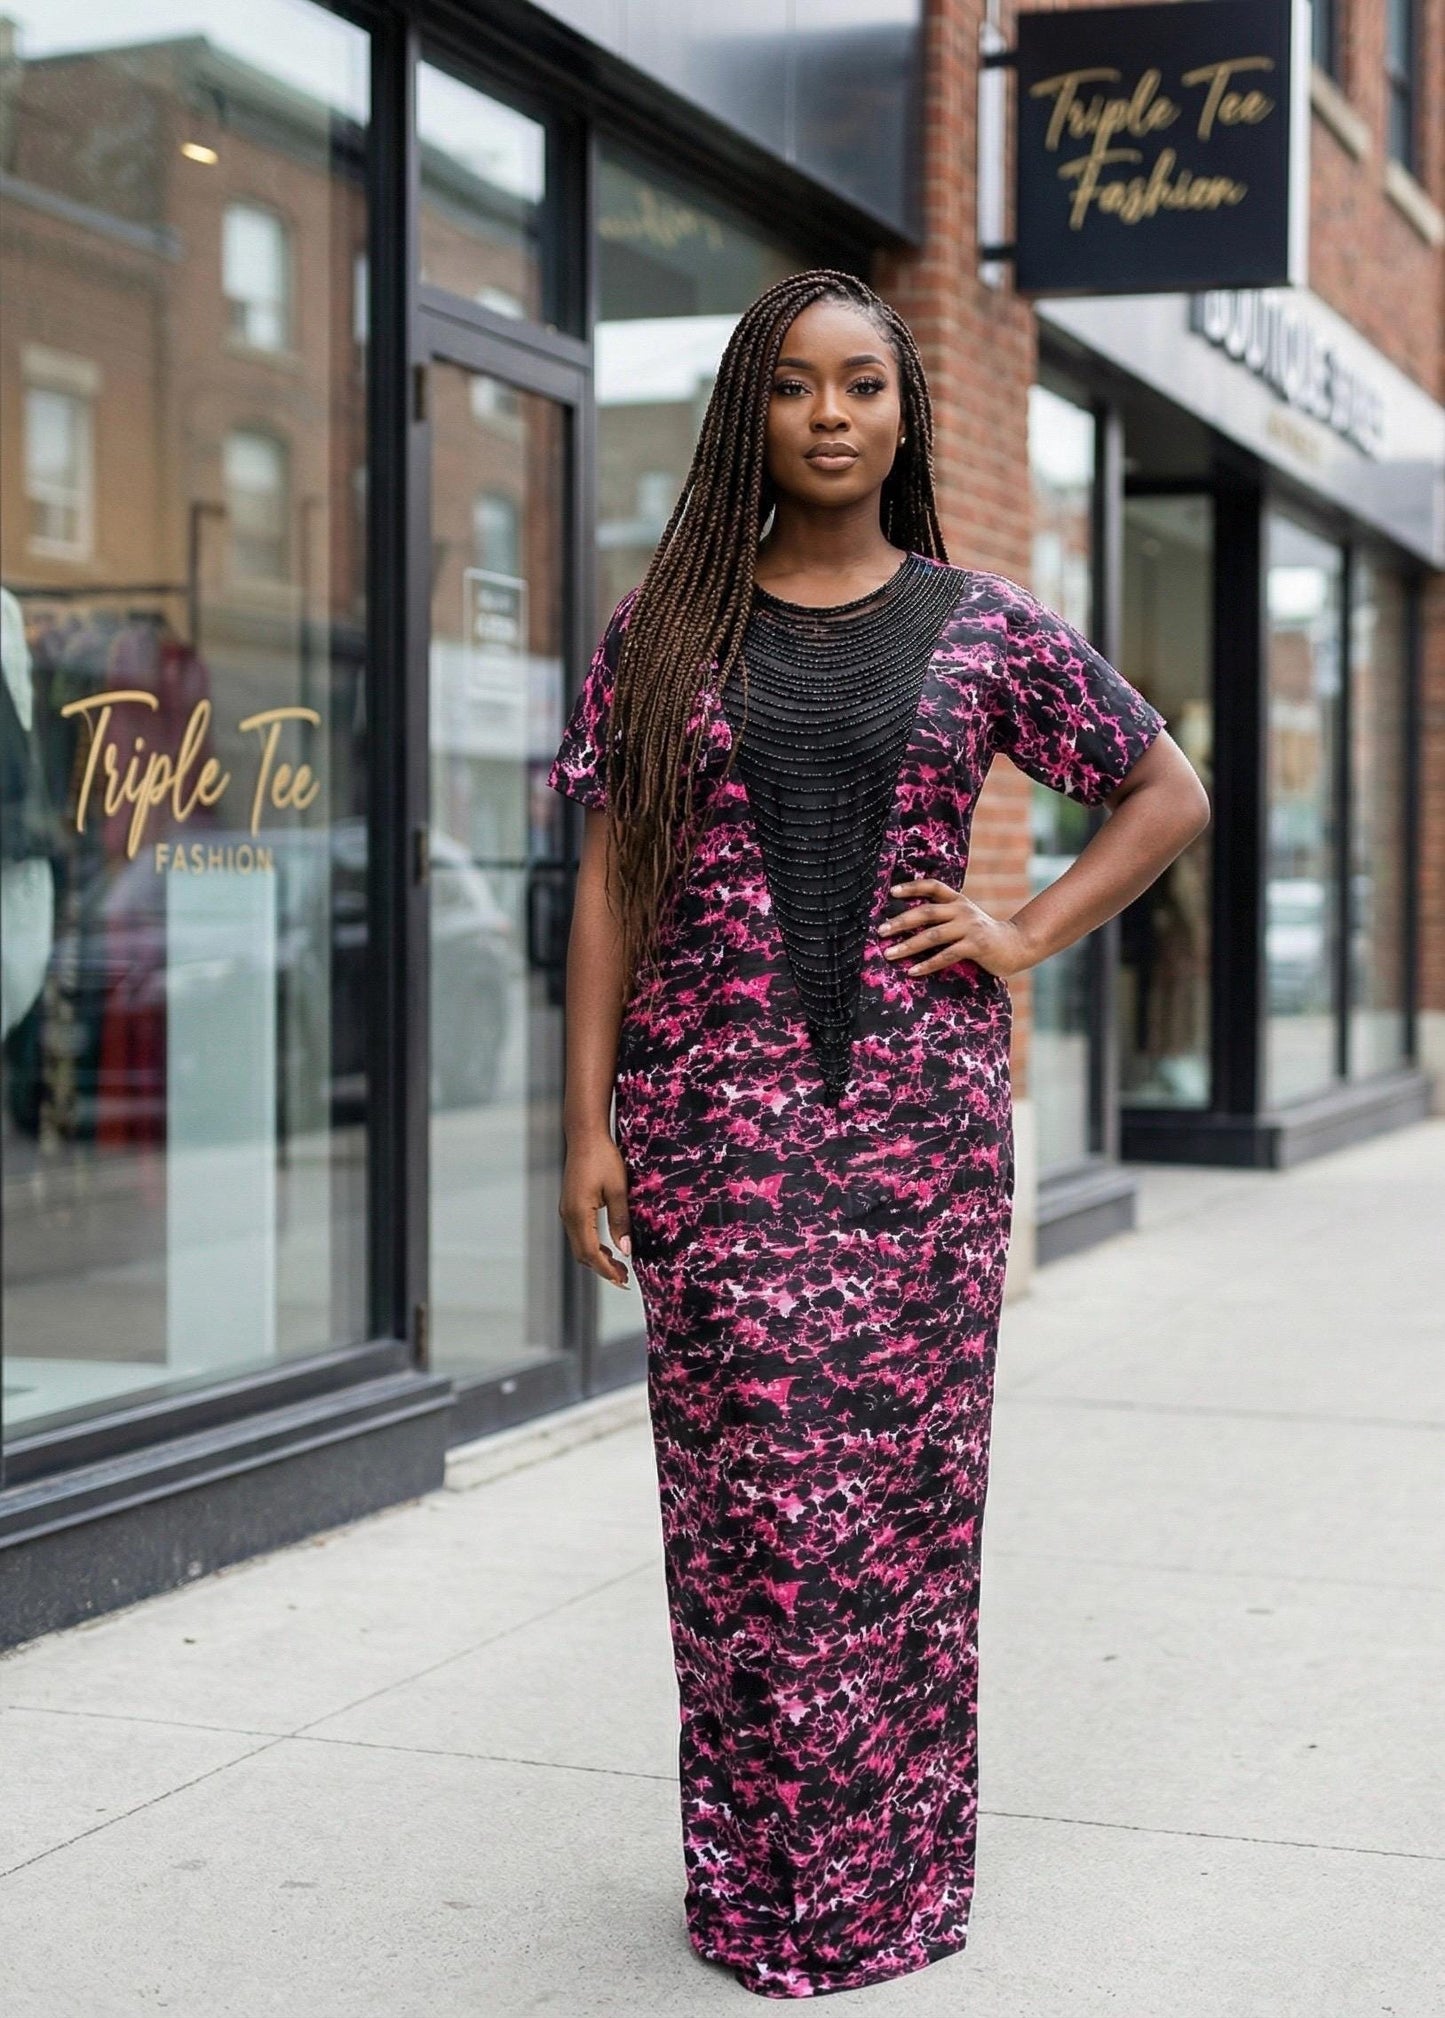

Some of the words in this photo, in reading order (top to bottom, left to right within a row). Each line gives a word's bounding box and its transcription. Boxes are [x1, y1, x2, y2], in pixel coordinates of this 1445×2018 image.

[1030, 67, 1181, 158] Triple
[1181, 56, 1275, 141] Tee
[1058, 148, 1248, 230] Fashion
[61, 690, 231, 860] Triple
[239, 707, 321, 838] Tee
[155, 843, 275, 876] FASHION
